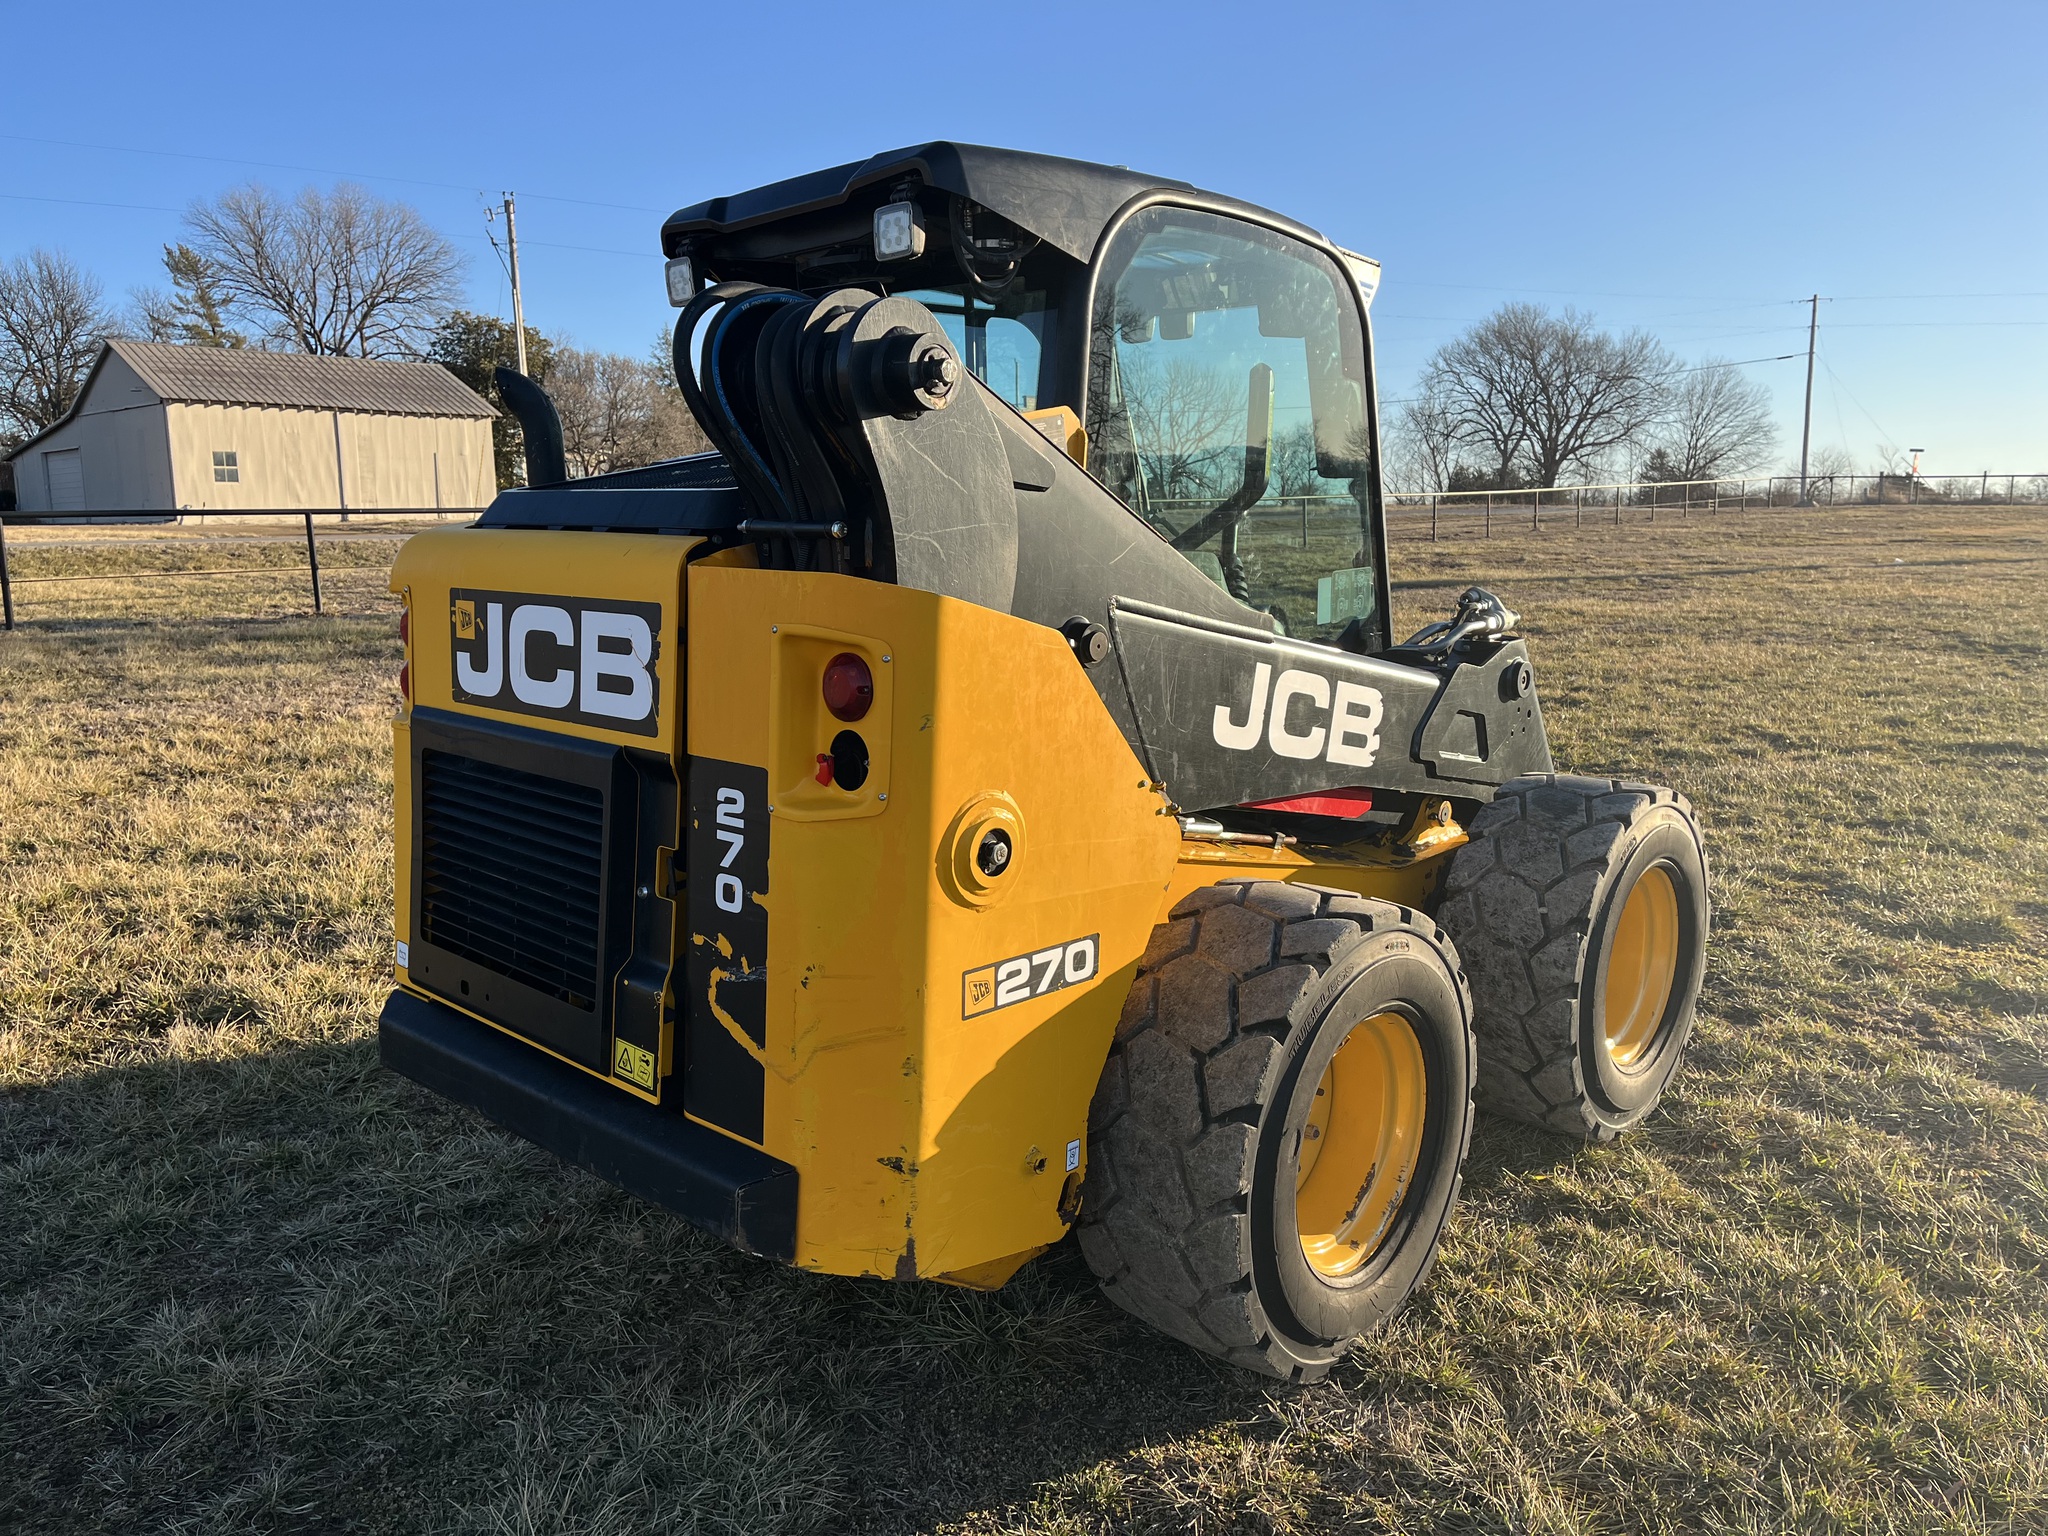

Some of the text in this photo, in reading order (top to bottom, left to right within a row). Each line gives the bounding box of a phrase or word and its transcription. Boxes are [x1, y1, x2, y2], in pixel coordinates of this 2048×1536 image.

[456, 602, 653, 721] JCB
[1212, 662, 1384, 768] JCB
[716, 787, 745, 914] 270
[972, 939, 1095, 1007] JCB 270
